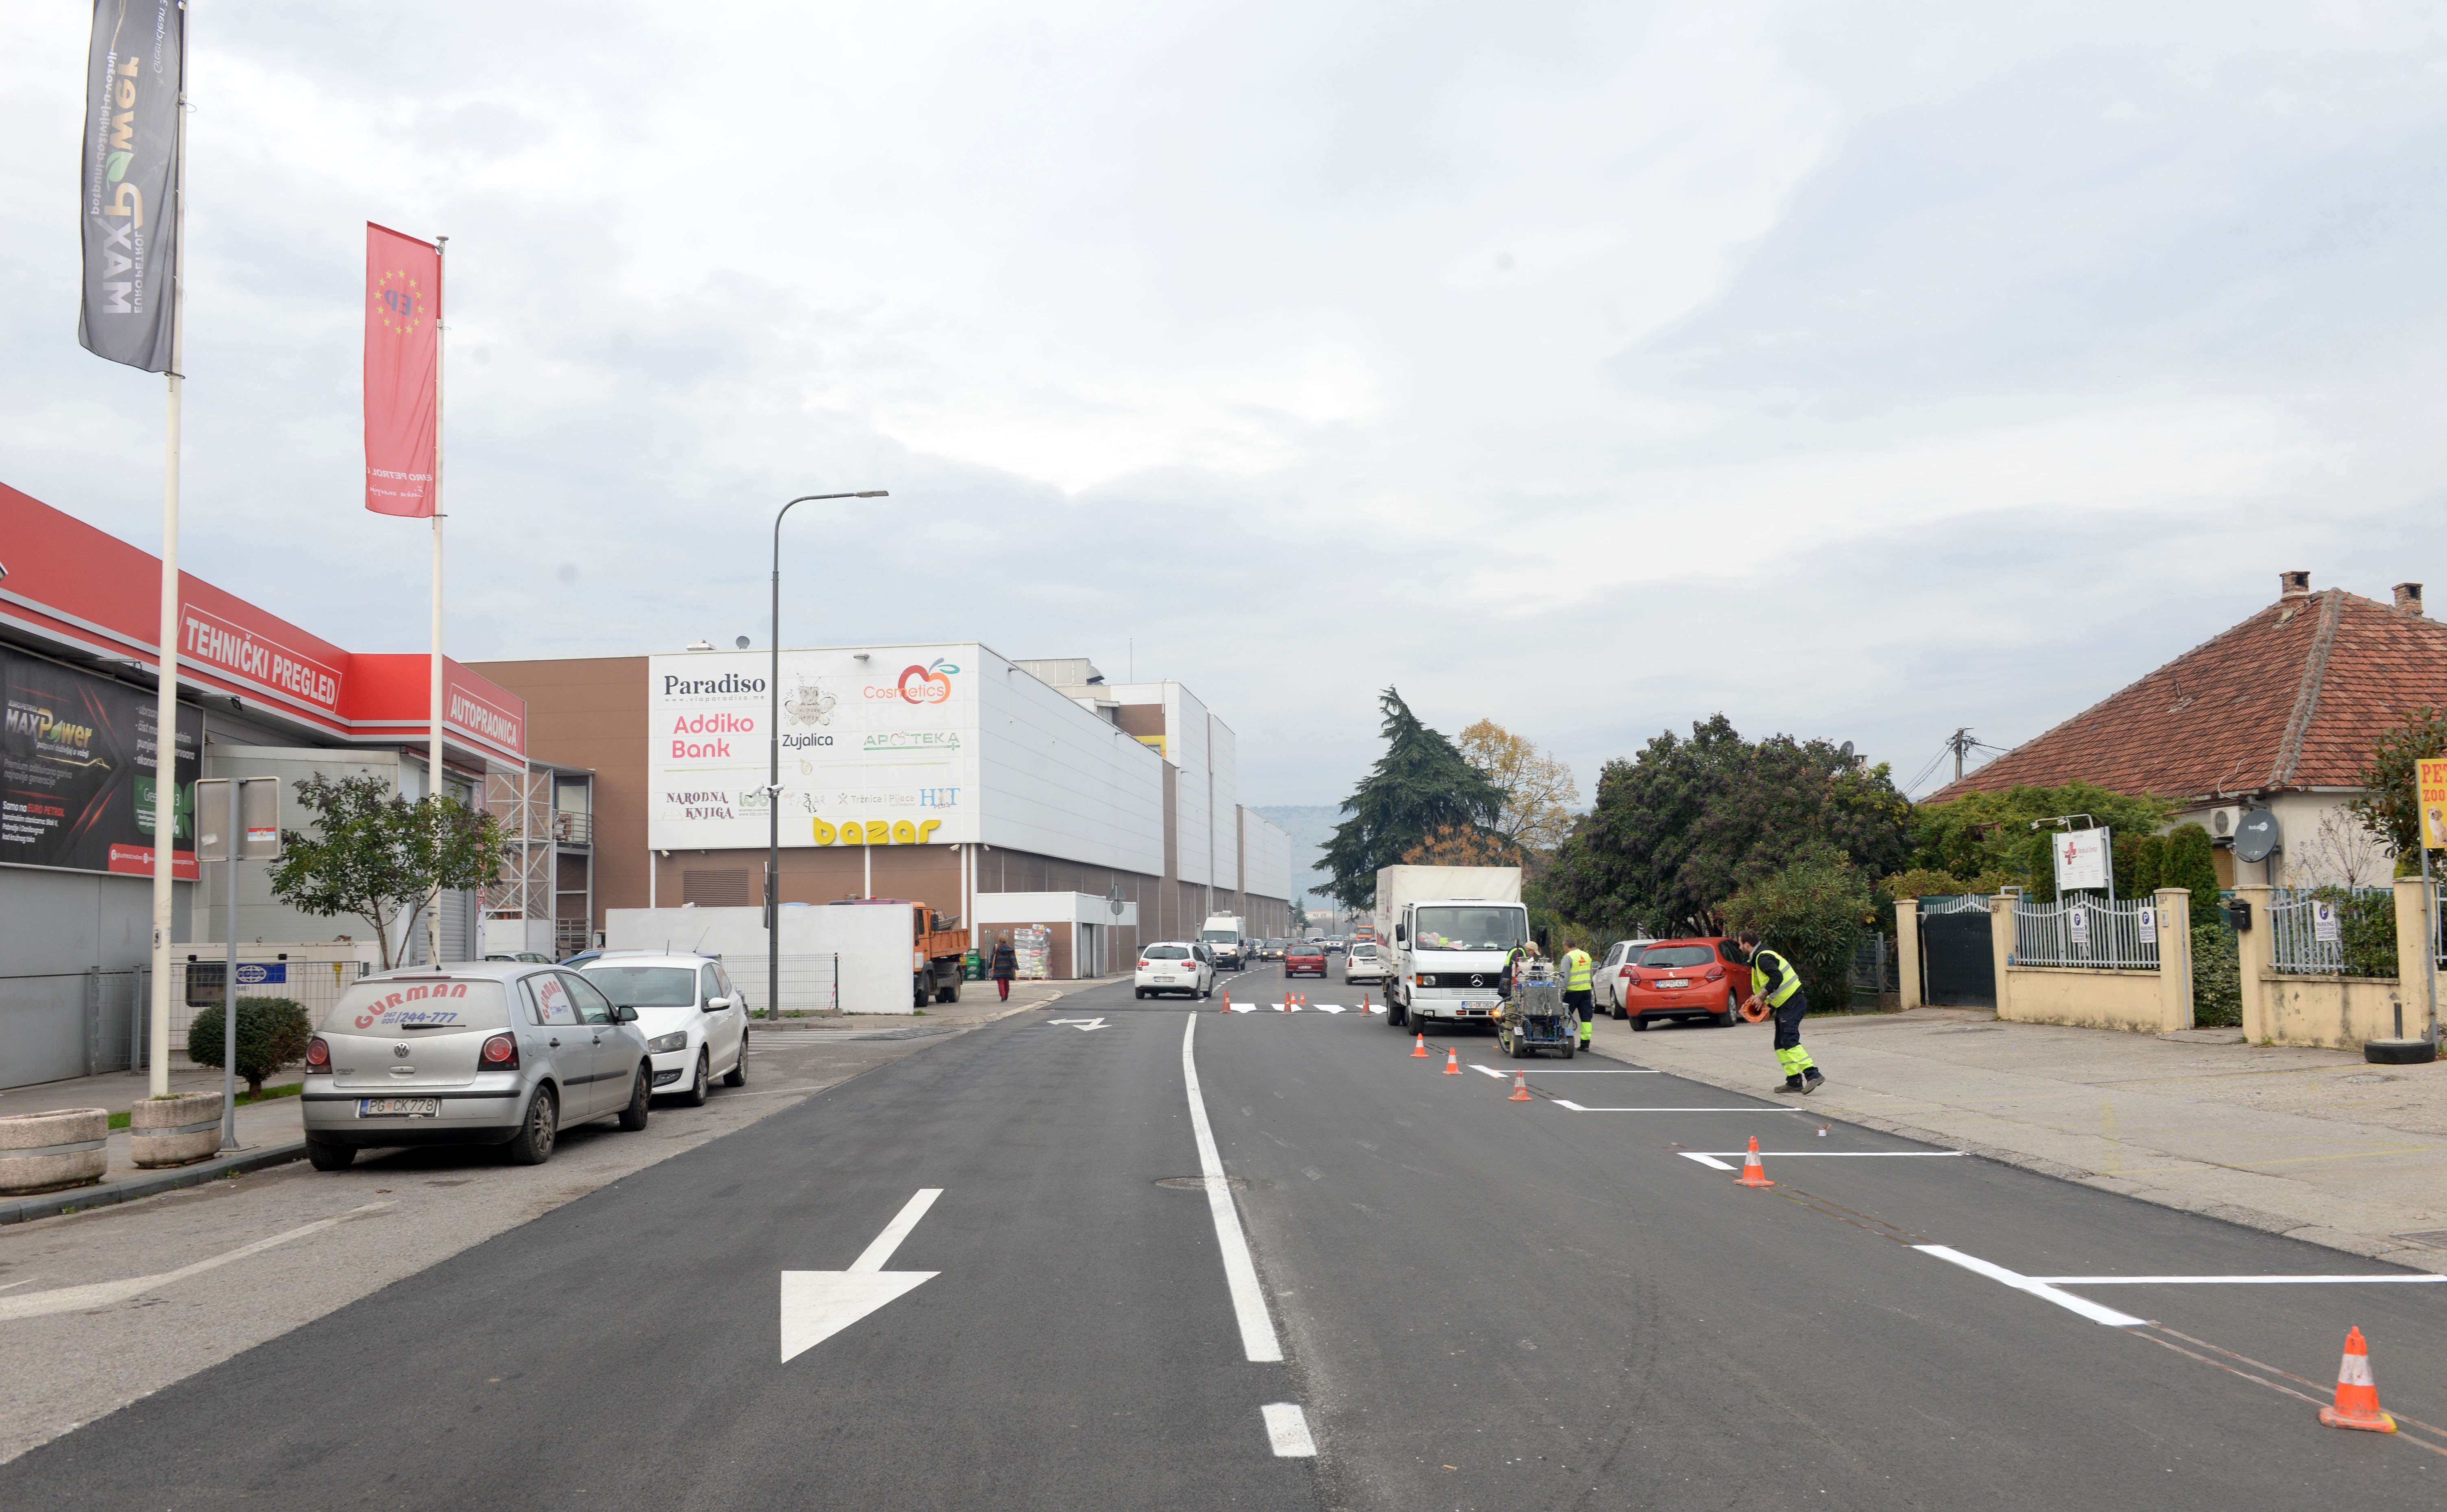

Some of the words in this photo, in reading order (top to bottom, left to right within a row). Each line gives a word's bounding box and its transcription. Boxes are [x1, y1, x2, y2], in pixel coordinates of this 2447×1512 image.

[186, 617, 269, 679] TEHNIČKI
[272, 654, 335, 705] PREGLED
[664, 674, 766, 695] Paradiso
[864, 685, 944, 699] Cosmetics
[450, 694, 517, 746] AUTOPRAONICA
[674, 713, 754, 734] Addiko
[672, 738, 731, 758] Bank
[782, 733, 833, 750] Zujalica
[666, 792, 728, 805] NARODNA
[851, 793, 882, 803] Tržnice
[889, 794, 914, 805] Pijace
[920, 788, 960, 806] HIT
[2423, 789, 2445, 801] ZOO
[685, 807, 734, 820] KNJIGA
[813, 817, 940, 845] bazar
[355, 984, 467, 1029] GURMAN
[369, 1100, 384, 1113] PG
